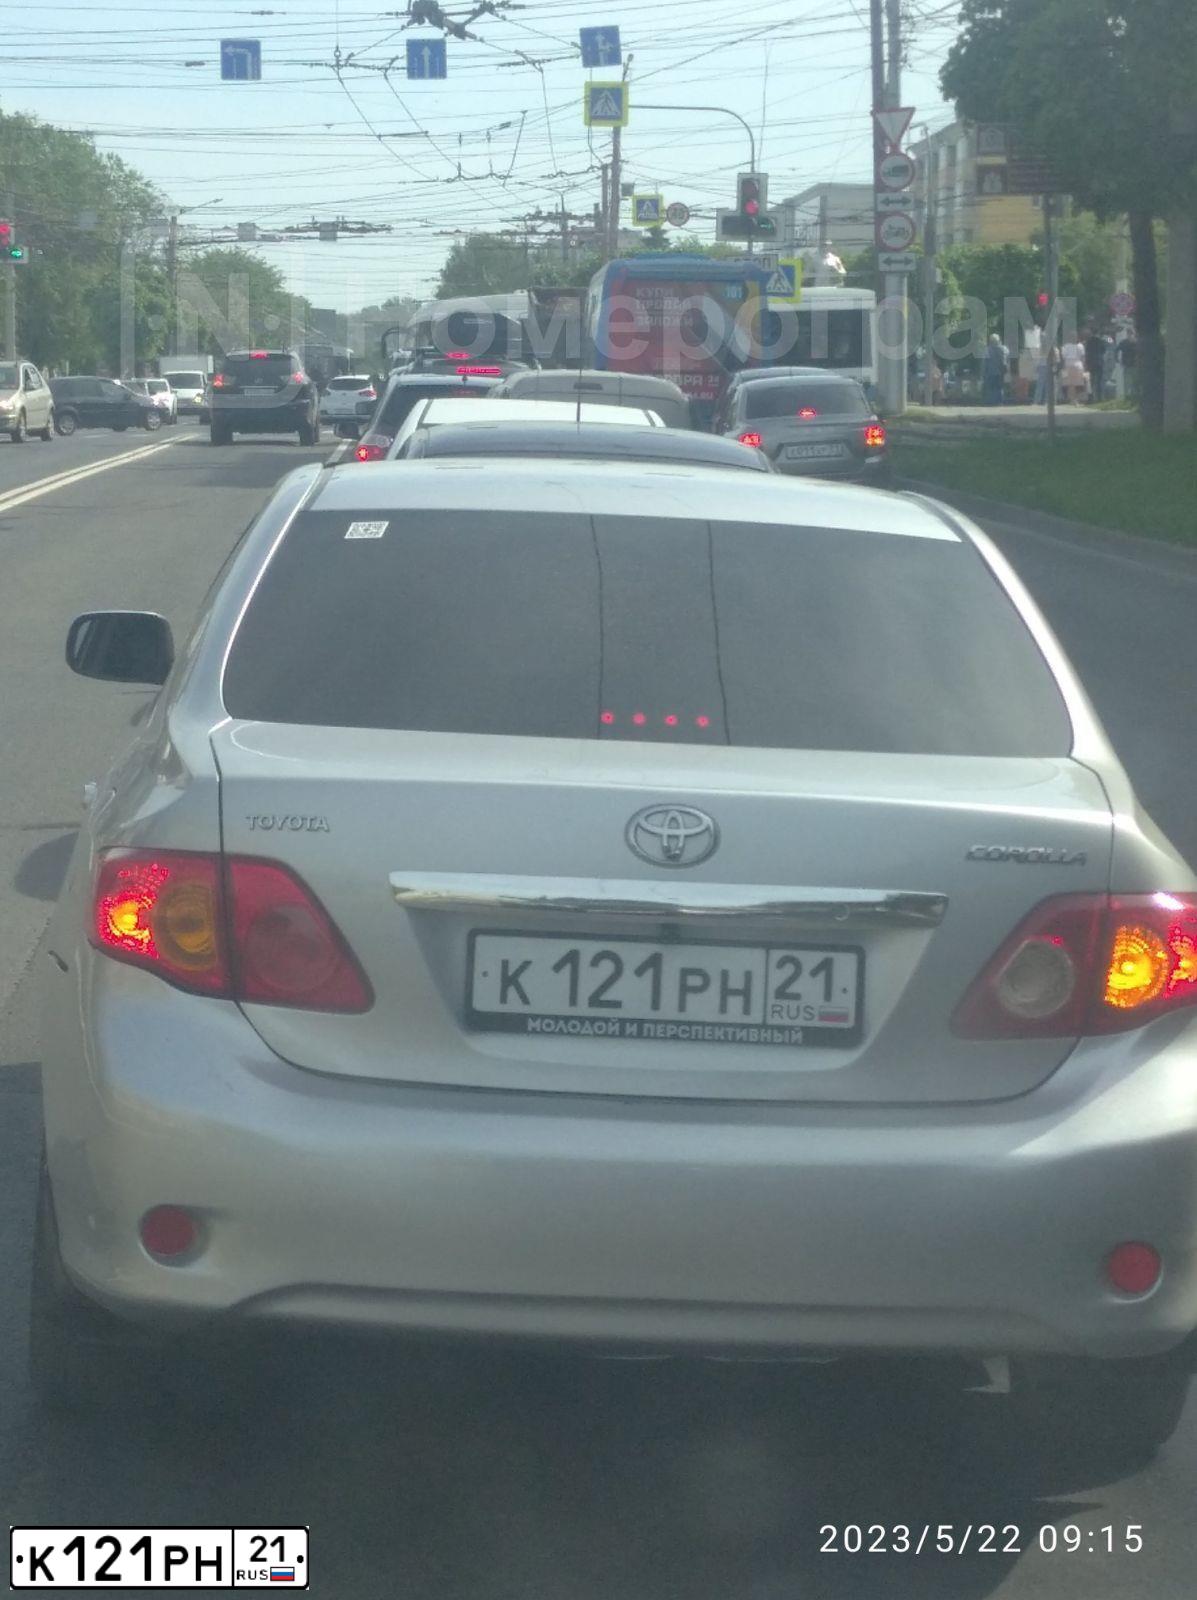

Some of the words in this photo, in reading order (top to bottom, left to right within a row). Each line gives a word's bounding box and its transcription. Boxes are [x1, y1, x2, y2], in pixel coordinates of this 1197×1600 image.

[246, 815, 330, 832] TOYOTA
[966, 844, 1087, 866] COROLLA
[774, 955, 834, 1001] 21
[771, 1004, 814, 1020] RUS
[527, 1016, 620, 1036] МОЛОДОЙ
[626, 1024, 638, 1036] И
[642, 1023, 804, 1044] ПЕРСПЕКТИВНЫЙ
